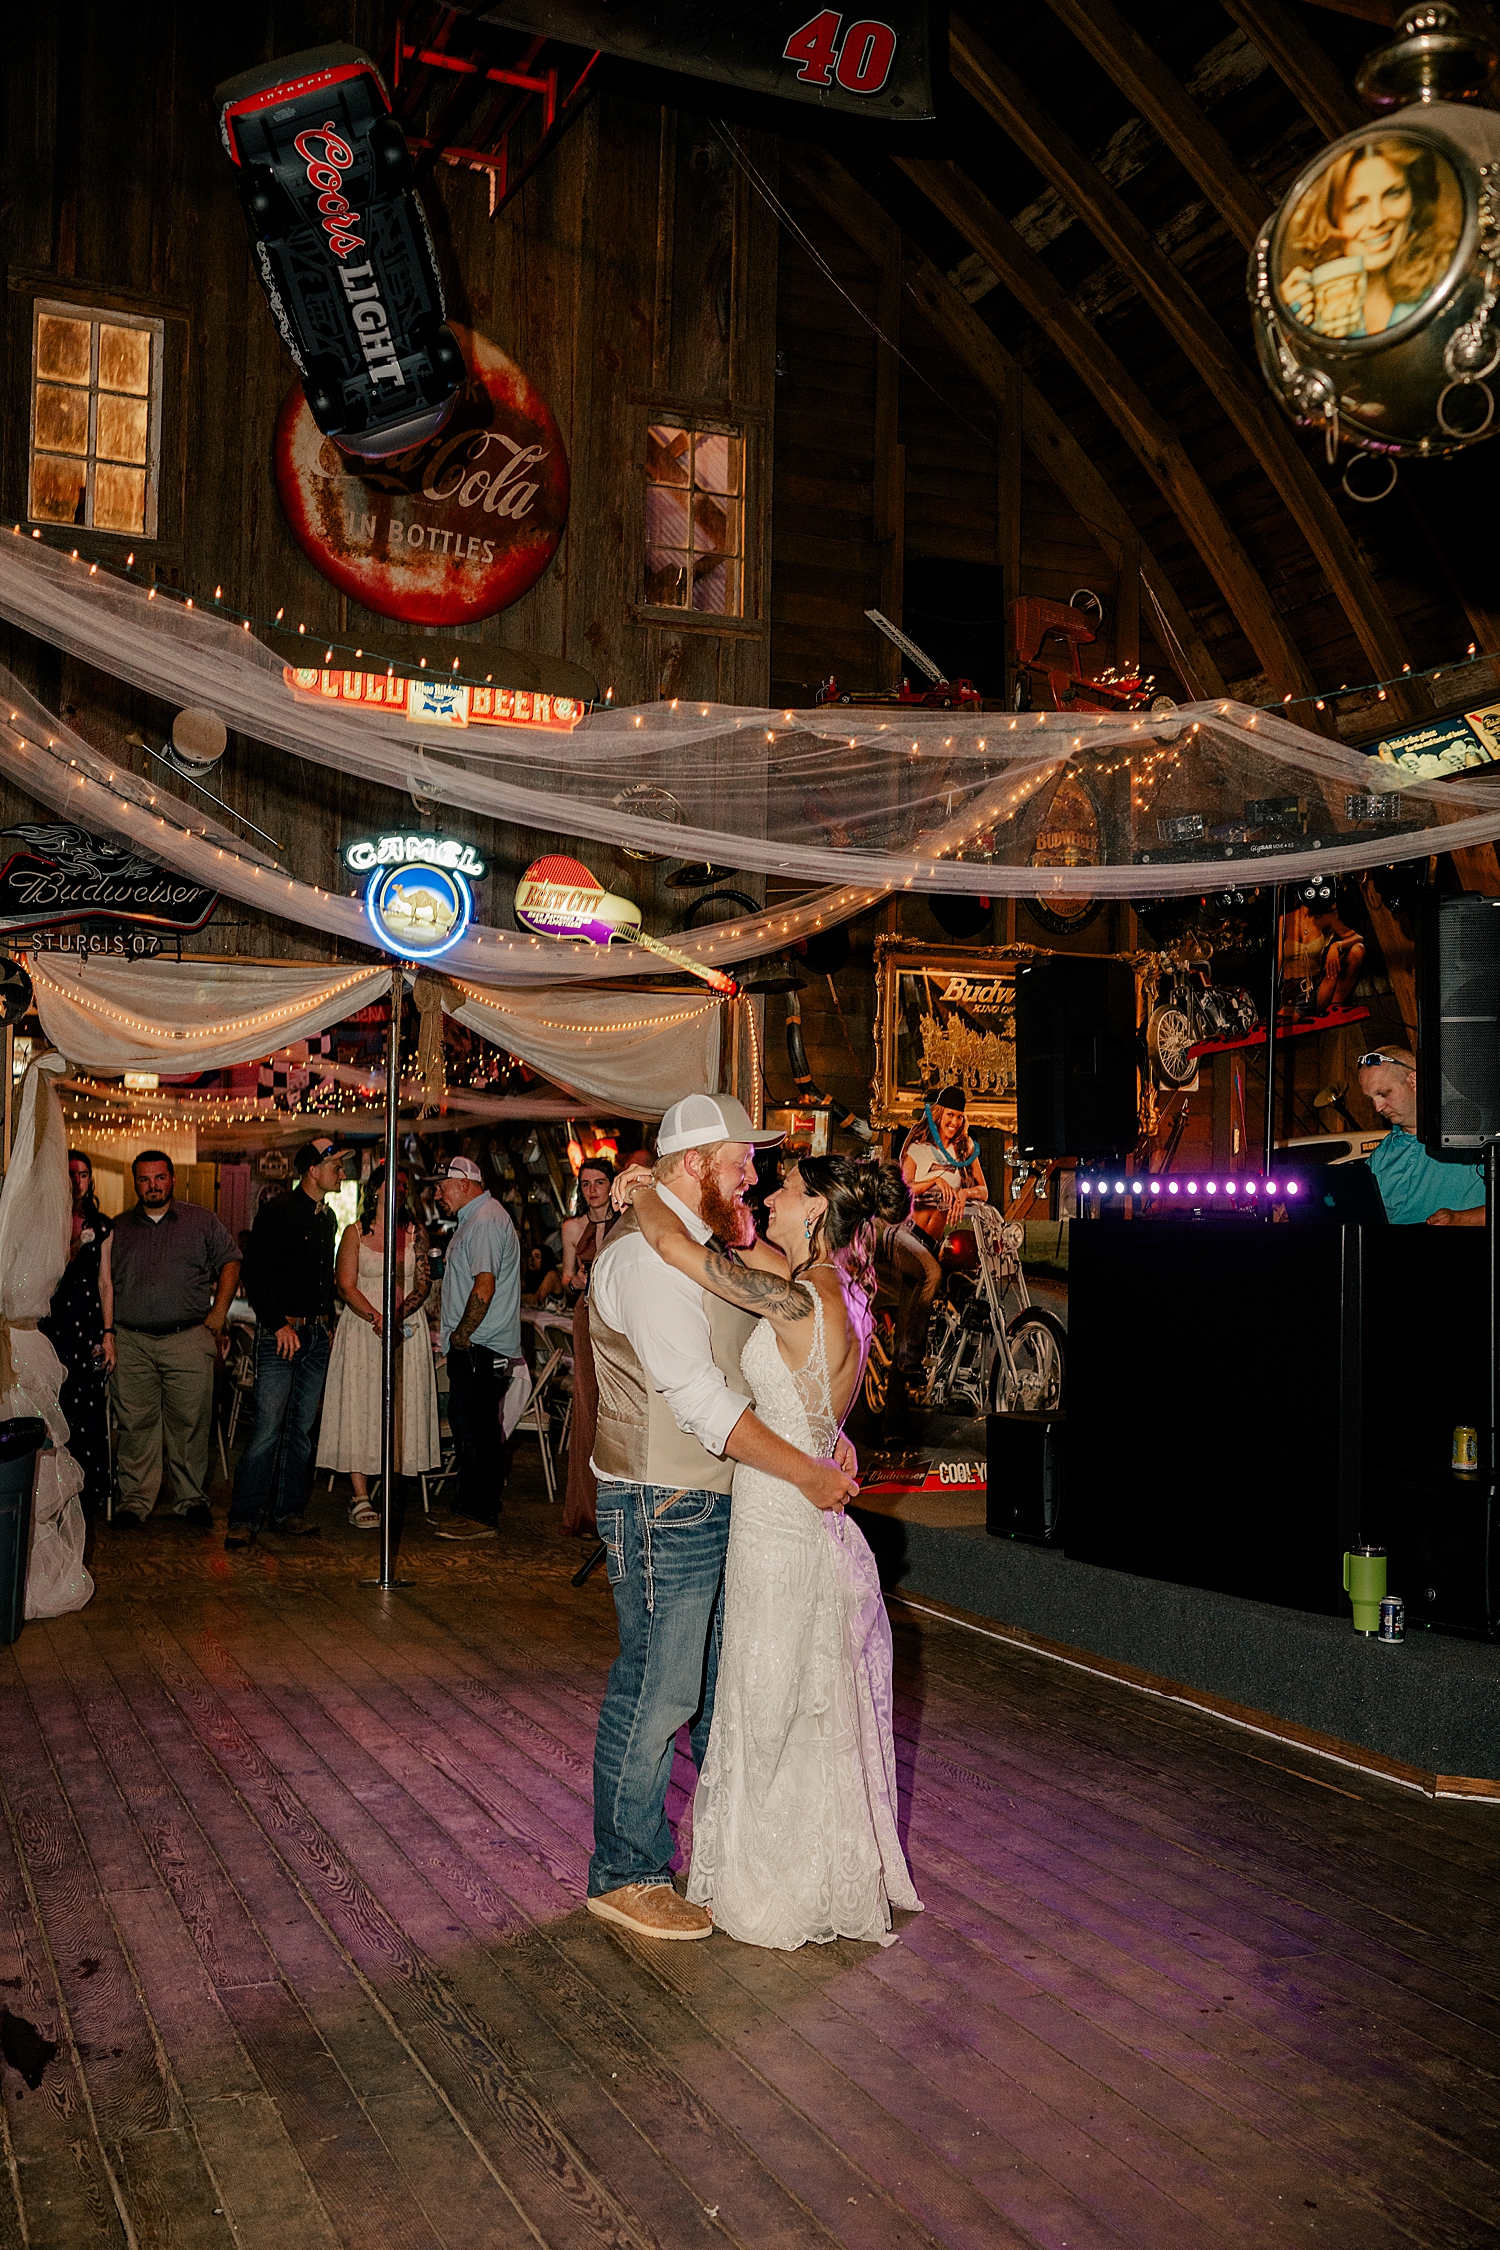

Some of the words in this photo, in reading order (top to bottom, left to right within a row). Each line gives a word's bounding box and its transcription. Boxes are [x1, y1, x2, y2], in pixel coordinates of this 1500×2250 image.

[782, 8, 897, 94] 40
[259, 73, 333, 103] INTREPID
[294, 120, 366, 259] Coors
[337, 259, 406, 387] LIGHT
[350, 511, 377, 539] IN
[388, 519, 496, 564] BOTTLES
[347, 836, 484, 876] CAMEL
[9, 871, 210, 904] Budweiser
[521, 884, 569, 909] BREW
[566, 890, 605, 913] CITY
[32, 933, 124, 952] STURGIS
[972, 1004, 999, 1014] KING
[869, 1470, 926, 1482] Budweiser
[939, 1462, 976, 1484] COOL
